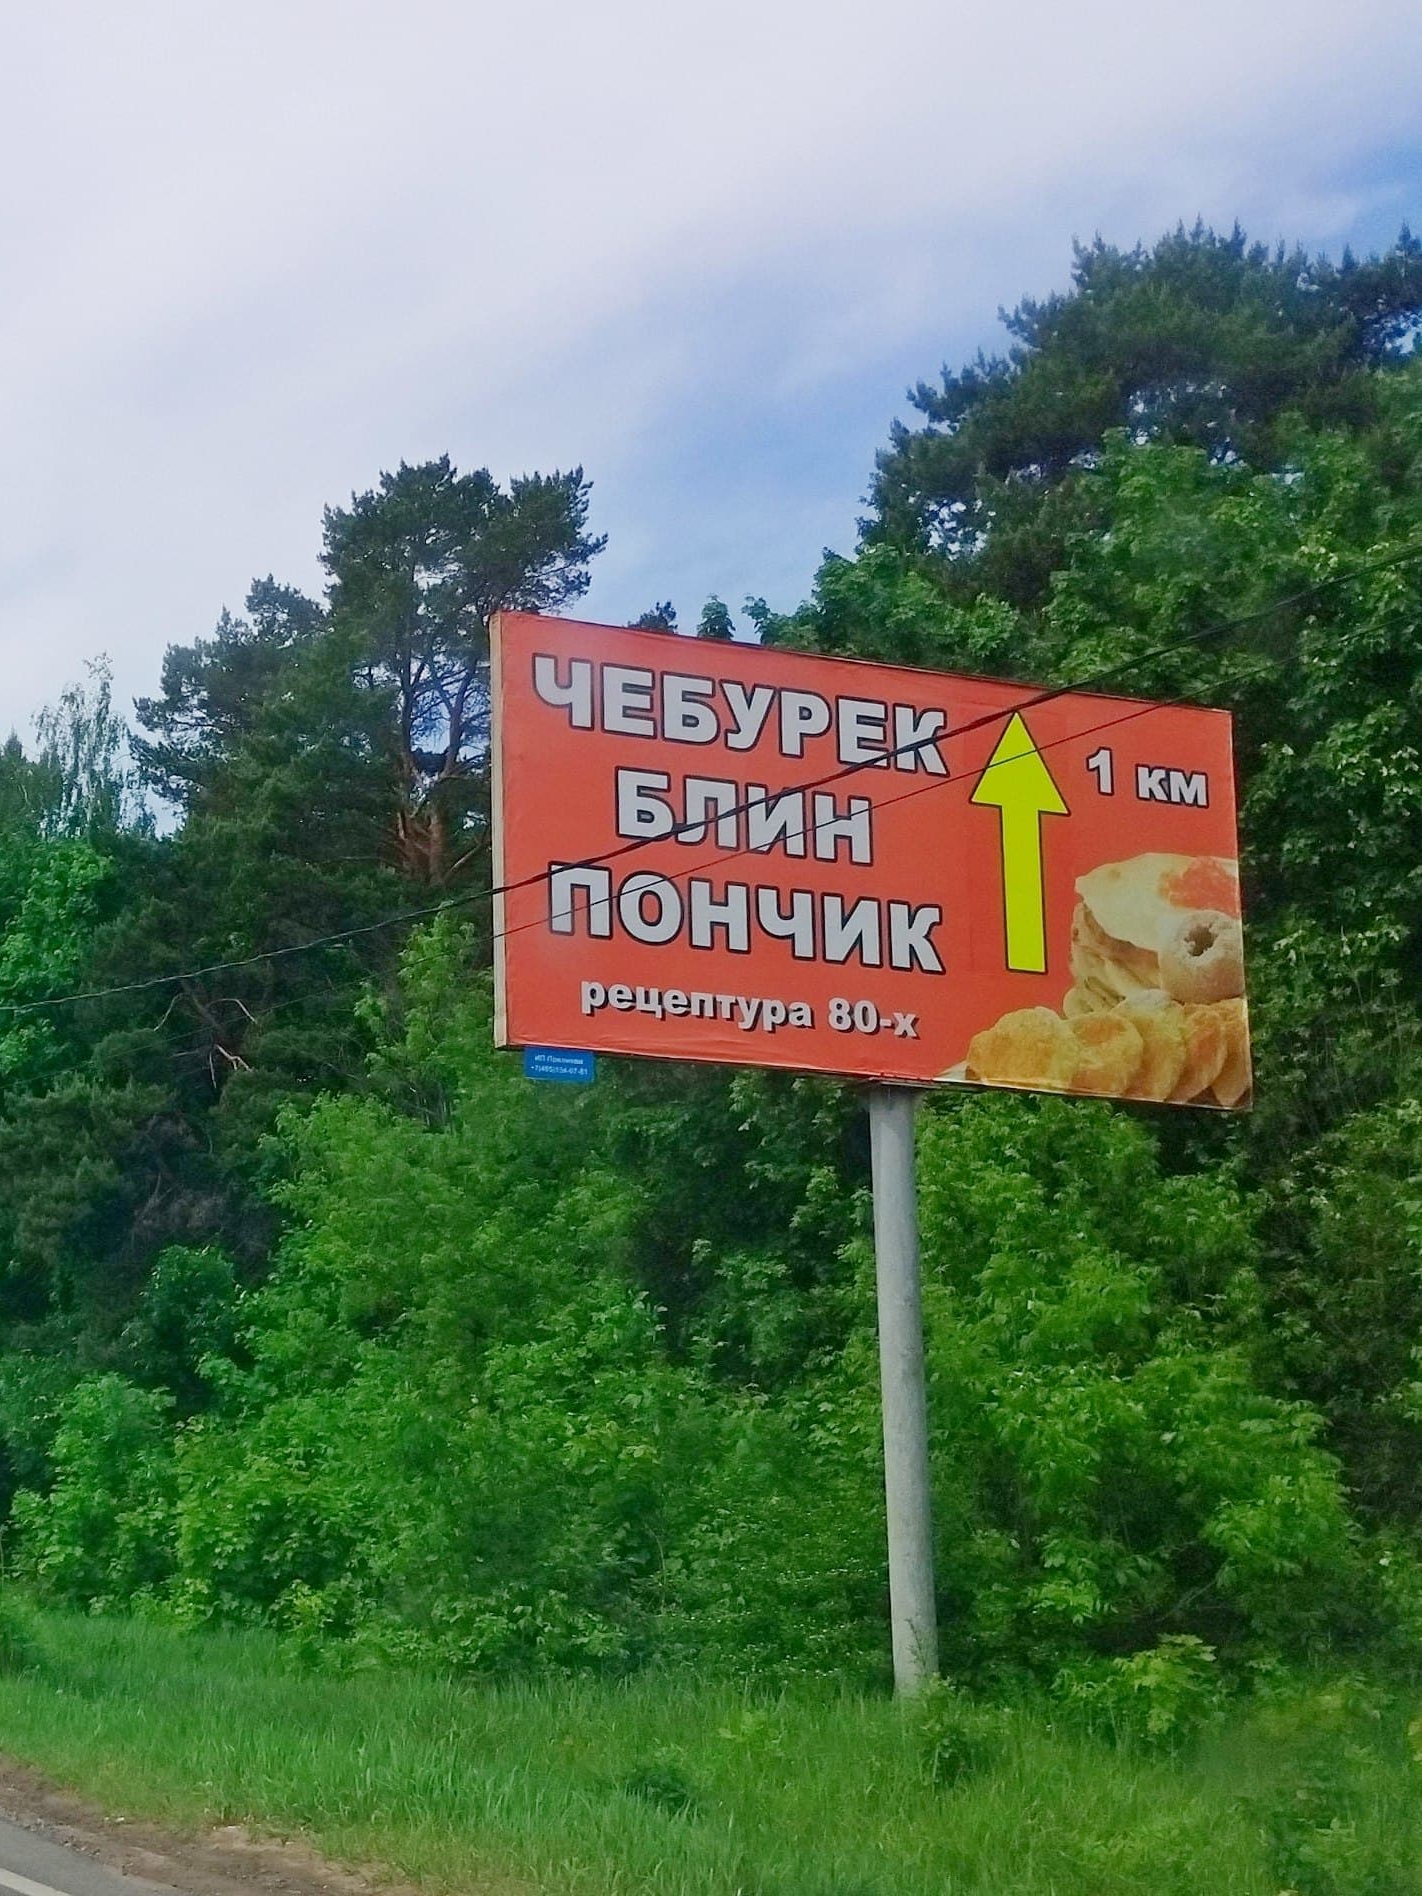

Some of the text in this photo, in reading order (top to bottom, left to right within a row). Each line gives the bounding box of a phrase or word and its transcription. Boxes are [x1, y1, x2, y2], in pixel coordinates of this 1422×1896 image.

[532, 654, 949, 776] ЧЕБУРЕК
[615, 767, 873, 865] БЛИН
[1086, 748, 1209, 808] 1 км
[548, 861, 946, 974] ПОНЧИК
[579, 979, 919, 1039] рецептура 80-х
